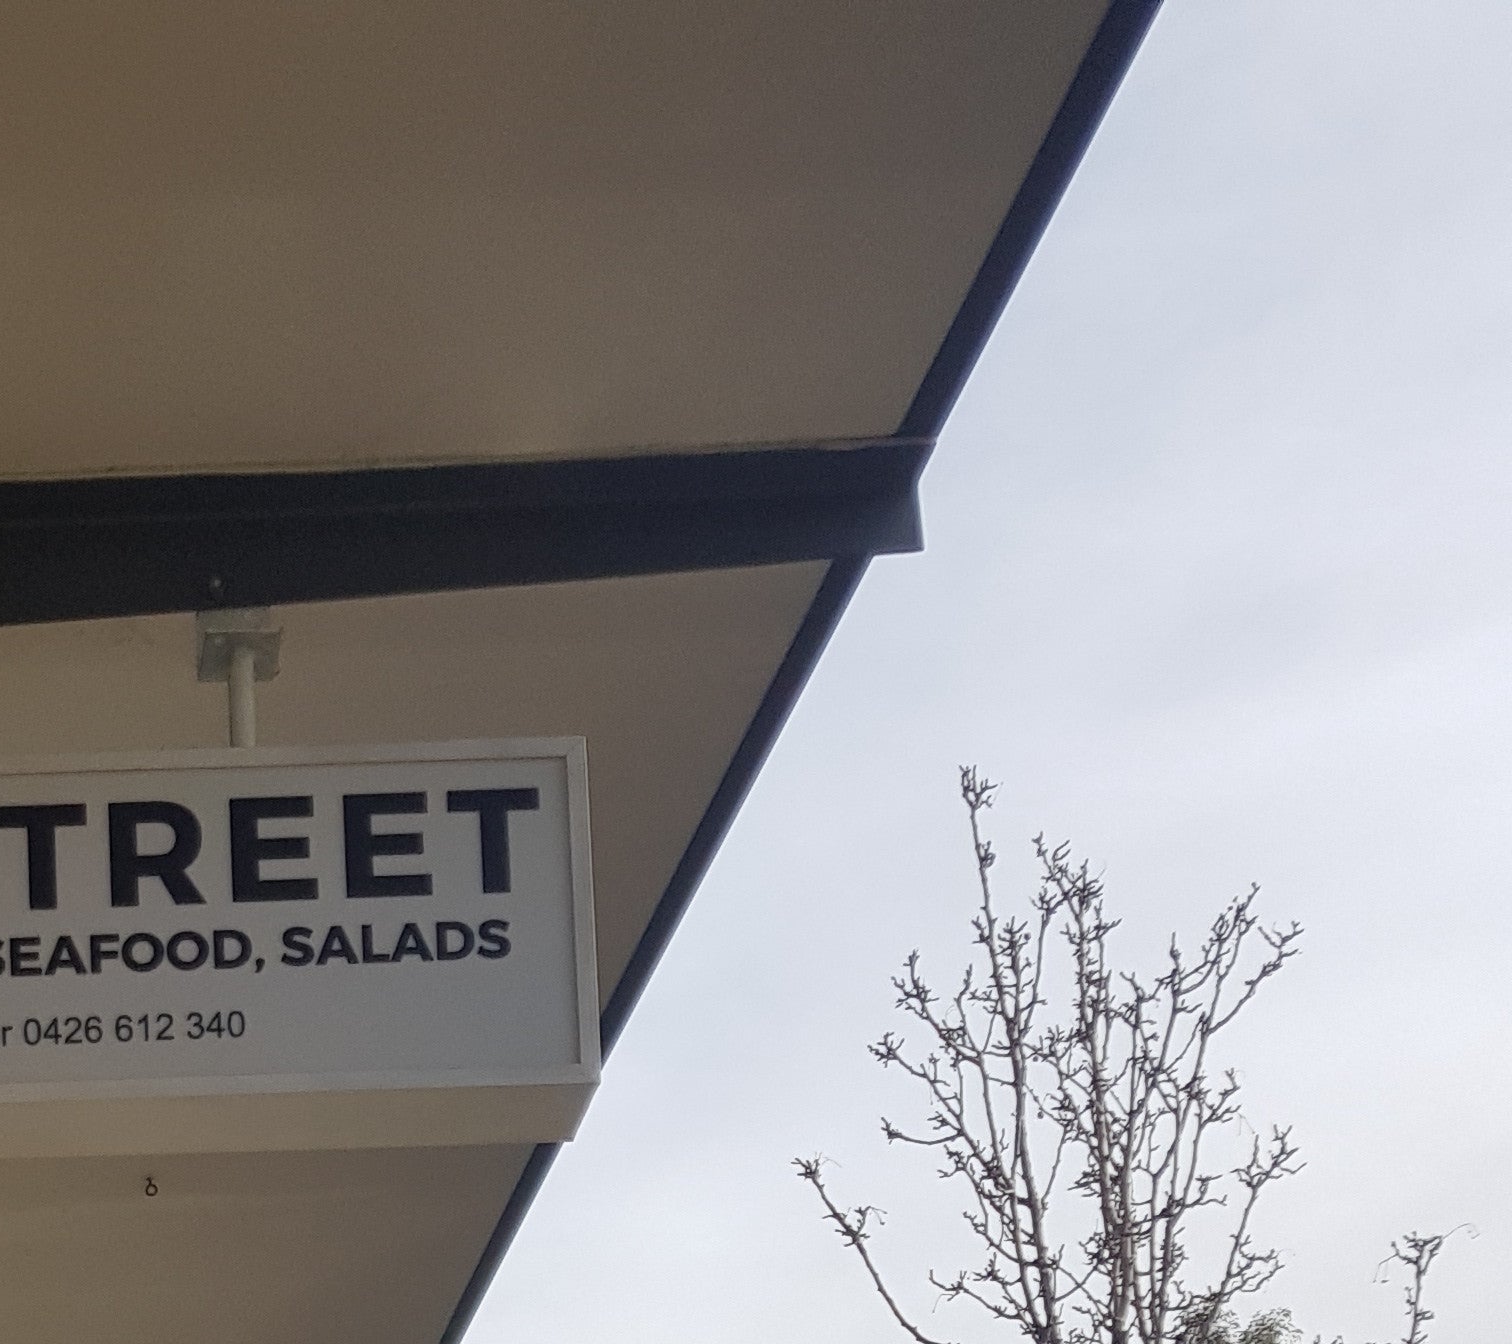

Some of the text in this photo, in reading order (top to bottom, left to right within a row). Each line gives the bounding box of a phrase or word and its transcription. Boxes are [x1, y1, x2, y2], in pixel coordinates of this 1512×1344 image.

[280, 919, 511, 967] SALADS
[22, 1014, 103, 1045] 0426
[114, 1011, 176, 1041] 612
[186, 1009, 246, 1040] 340
